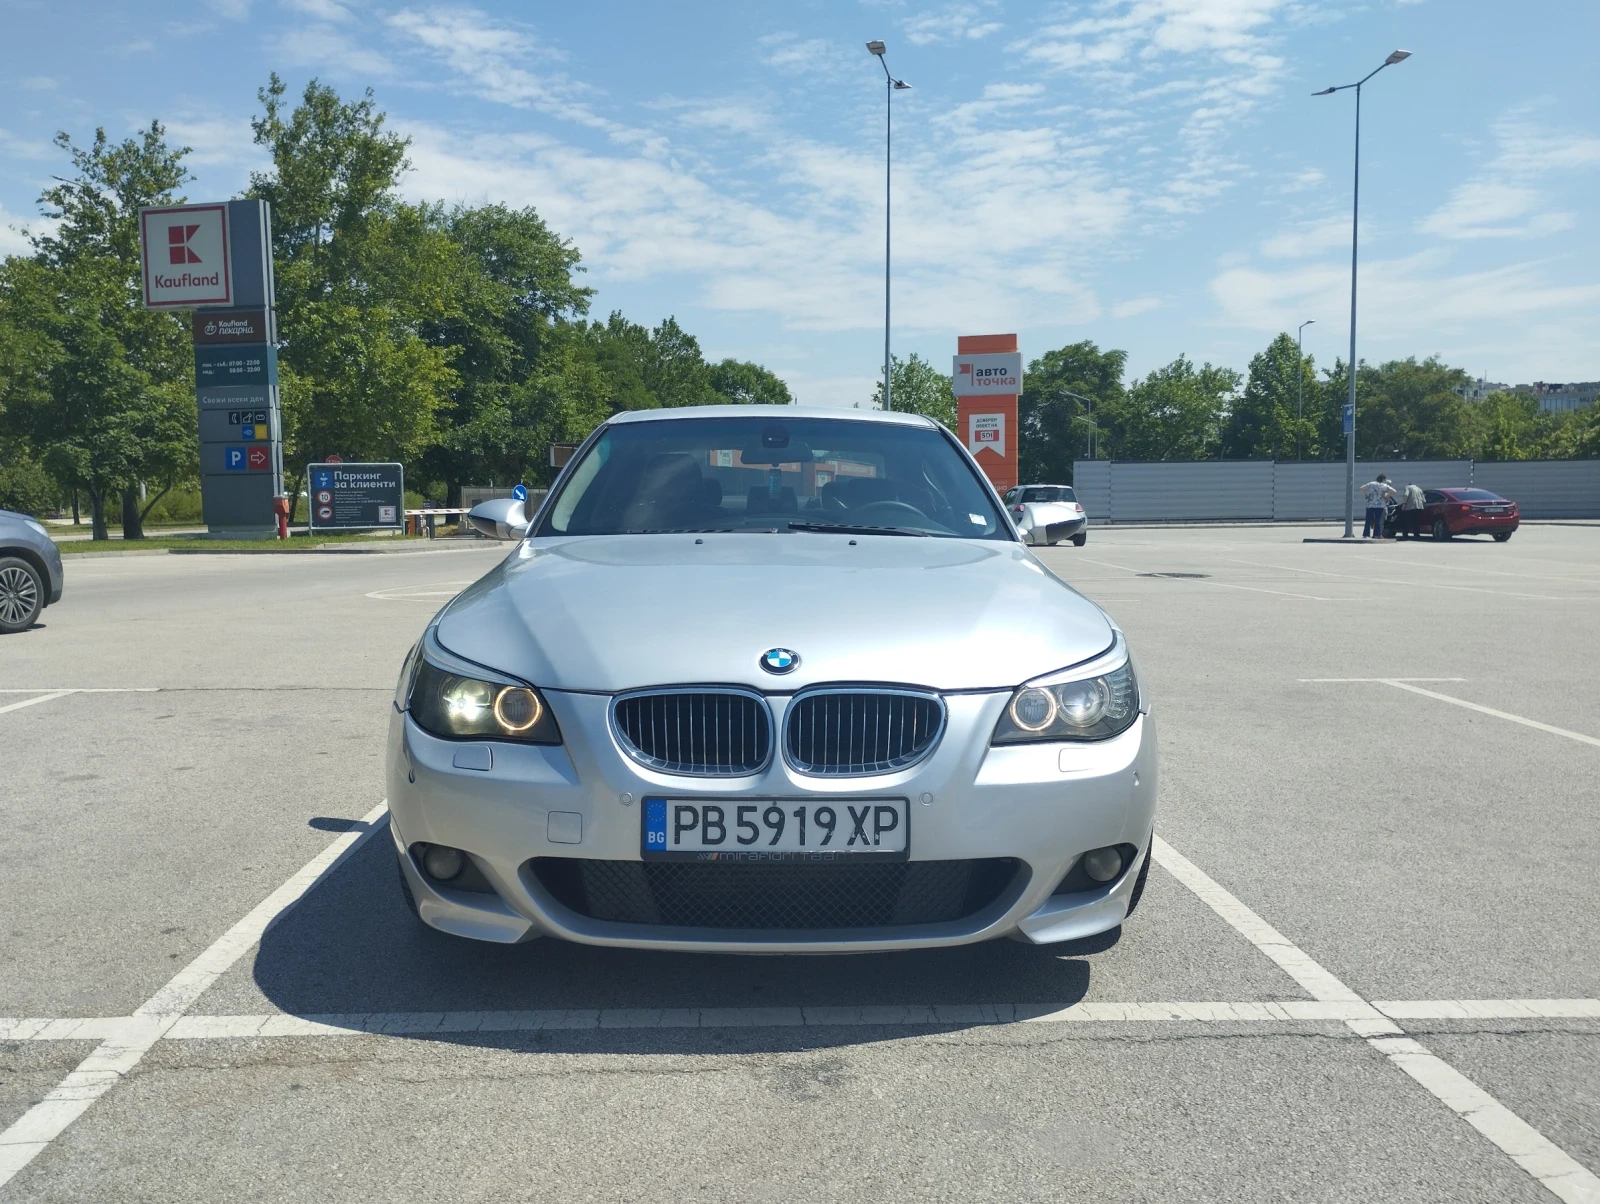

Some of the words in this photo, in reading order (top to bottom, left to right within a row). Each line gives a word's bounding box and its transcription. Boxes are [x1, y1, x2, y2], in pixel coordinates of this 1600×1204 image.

[155, 272, 219, 289] Kaufland
[218, 319, 248, 327] Kaufland
[218, 326, 255, 336] пекарна
[976, 367, 1008, 377] авто
[976, 376, 1016, 387] точка
[202, 396, 227, 404] Свежи
[249, 396, 264, 404] ден
[231, 450, 242, 466] P
[333, 470, 382, 482] Паркинг
[334, 481, 347, 489] за
[350, 480, 396, 489] клиенти
[320, 493, 329, 501] 10
[673, 805, 727, 845] PB
[736, 805, 837, 846] 5919
[846, 805, 899, 846] XP
[647, 831, 665, 844] BG
